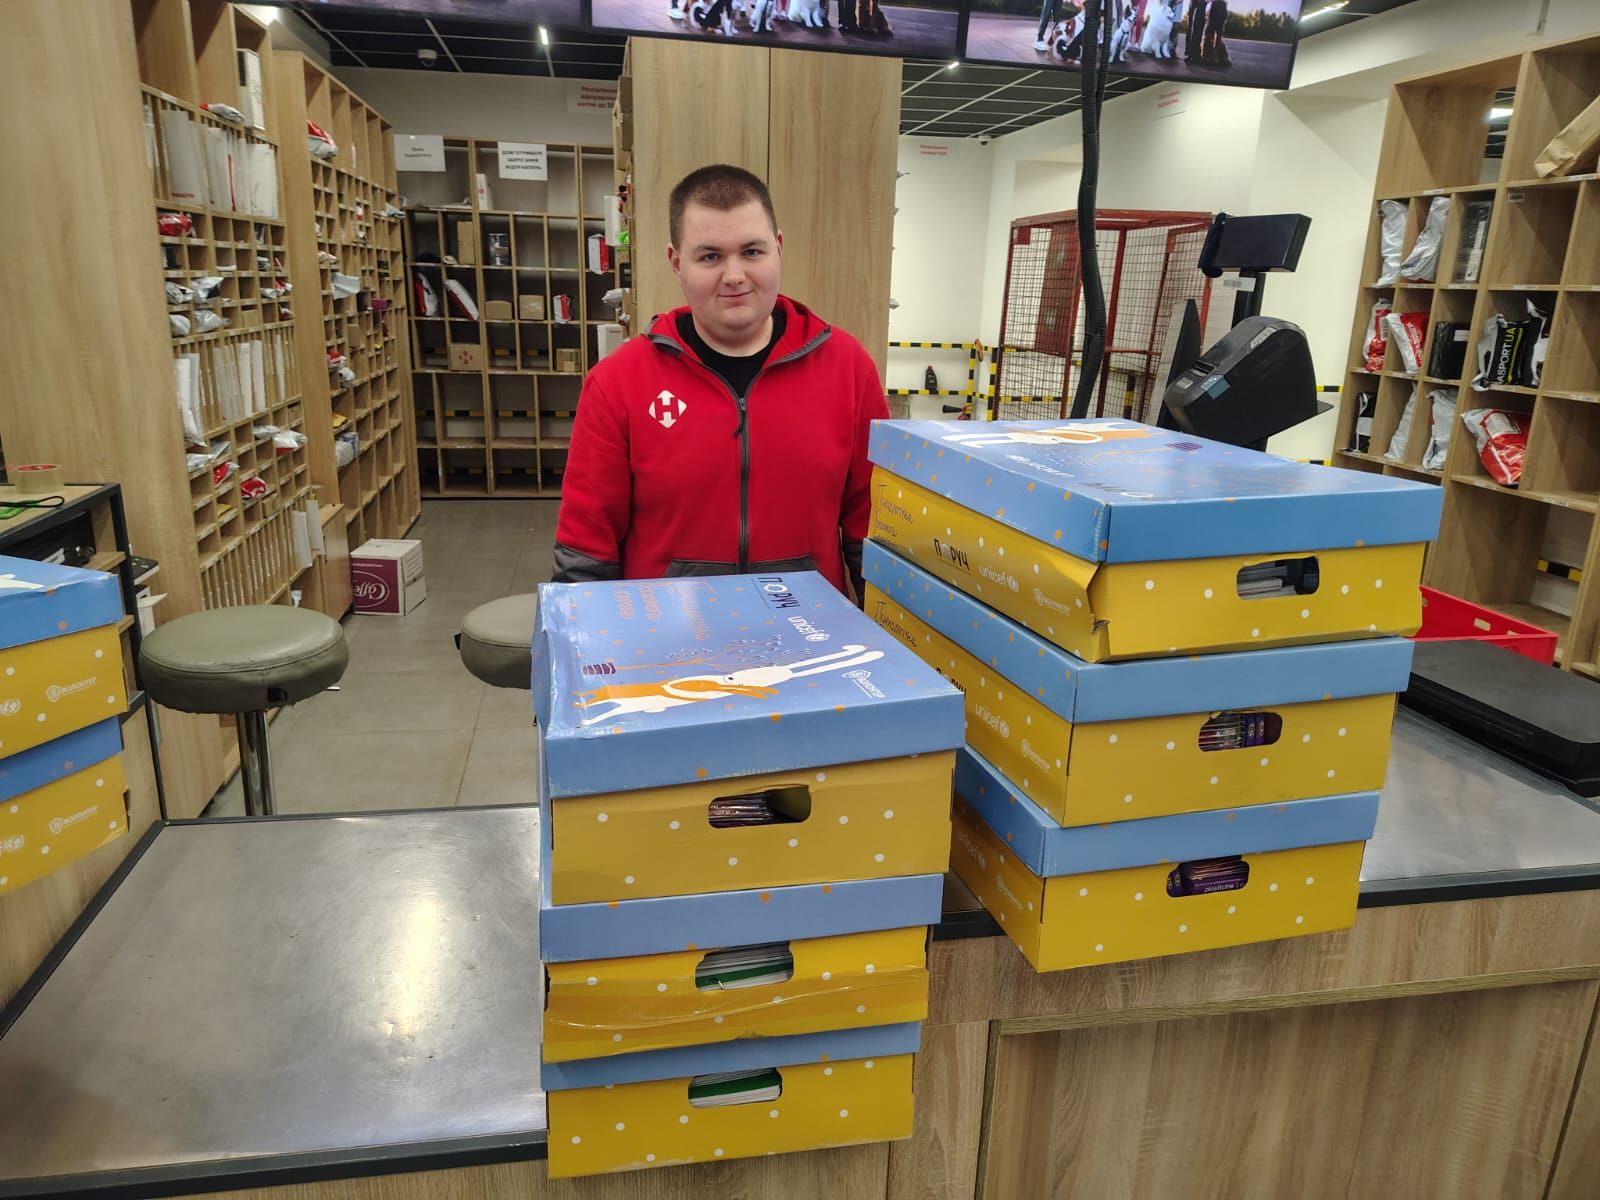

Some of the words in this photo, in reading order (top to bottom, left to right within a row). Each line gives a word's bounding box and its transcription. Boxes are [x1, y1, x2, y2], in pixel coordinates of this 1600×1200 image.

[1496, 344, 1513, 385] ASPORT
[934, 538, 970, 571] ПОРУЧ
[980, 565, 1008, 588] unicef
[757, 576, 801, 610] ПОРУЧ
[787, 615, 825, 637] unicef
[975, 703, 1001, 730] unicef
